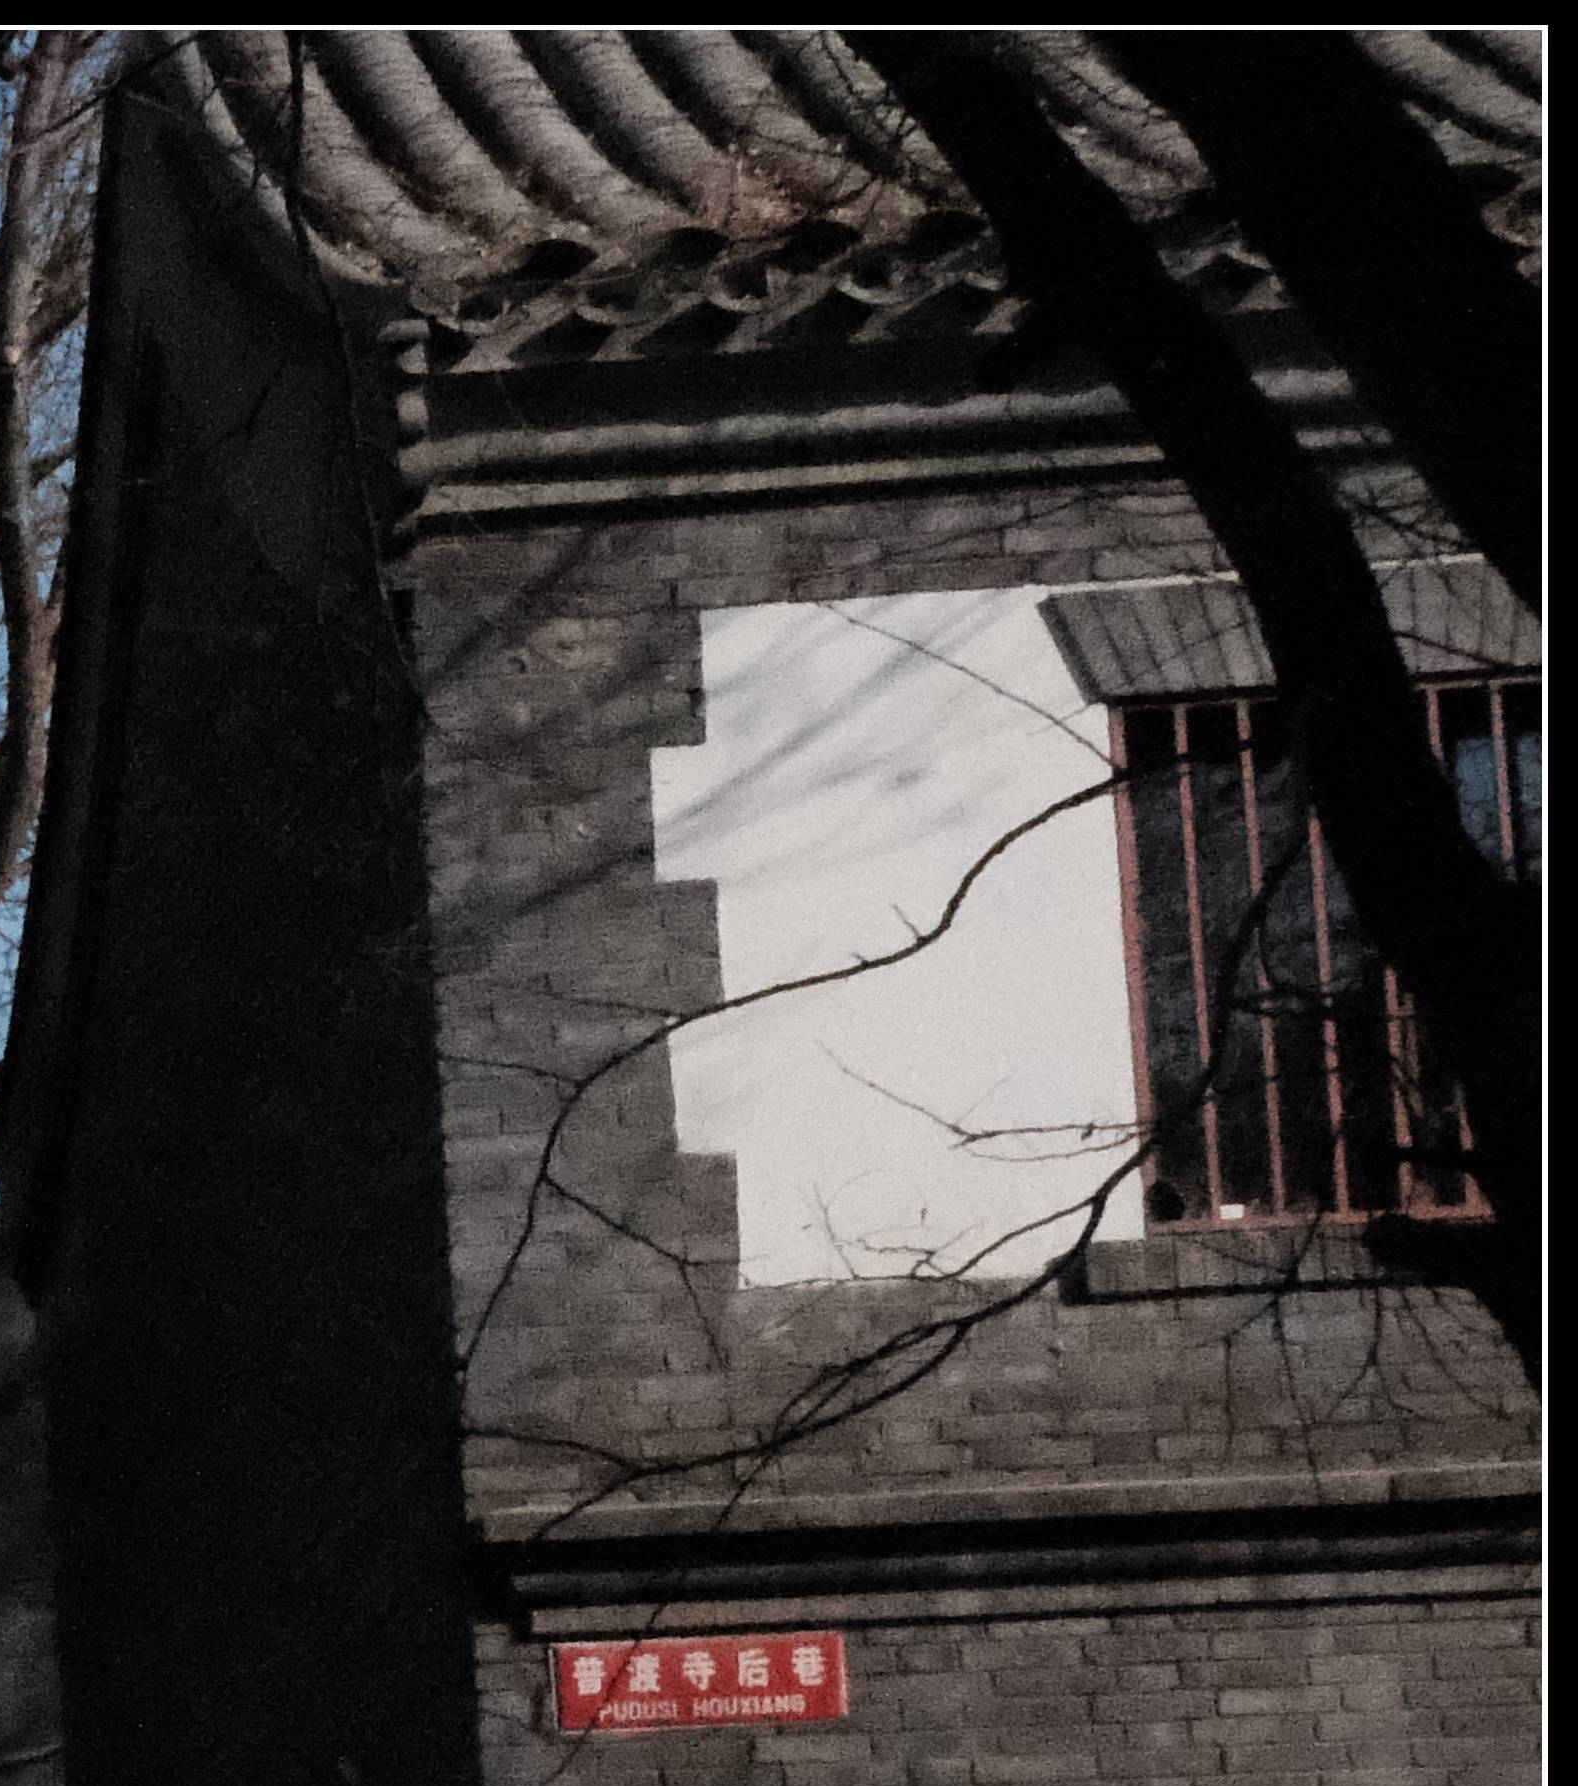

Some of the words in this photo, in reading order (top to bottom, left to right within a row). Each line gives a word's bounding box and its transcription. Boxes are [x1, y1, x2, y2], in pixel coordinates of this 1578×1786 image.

[573, 1646, 826, 1695] 普渡寺后巷
[693, 1694, 806, 1718] HOUXIANG
